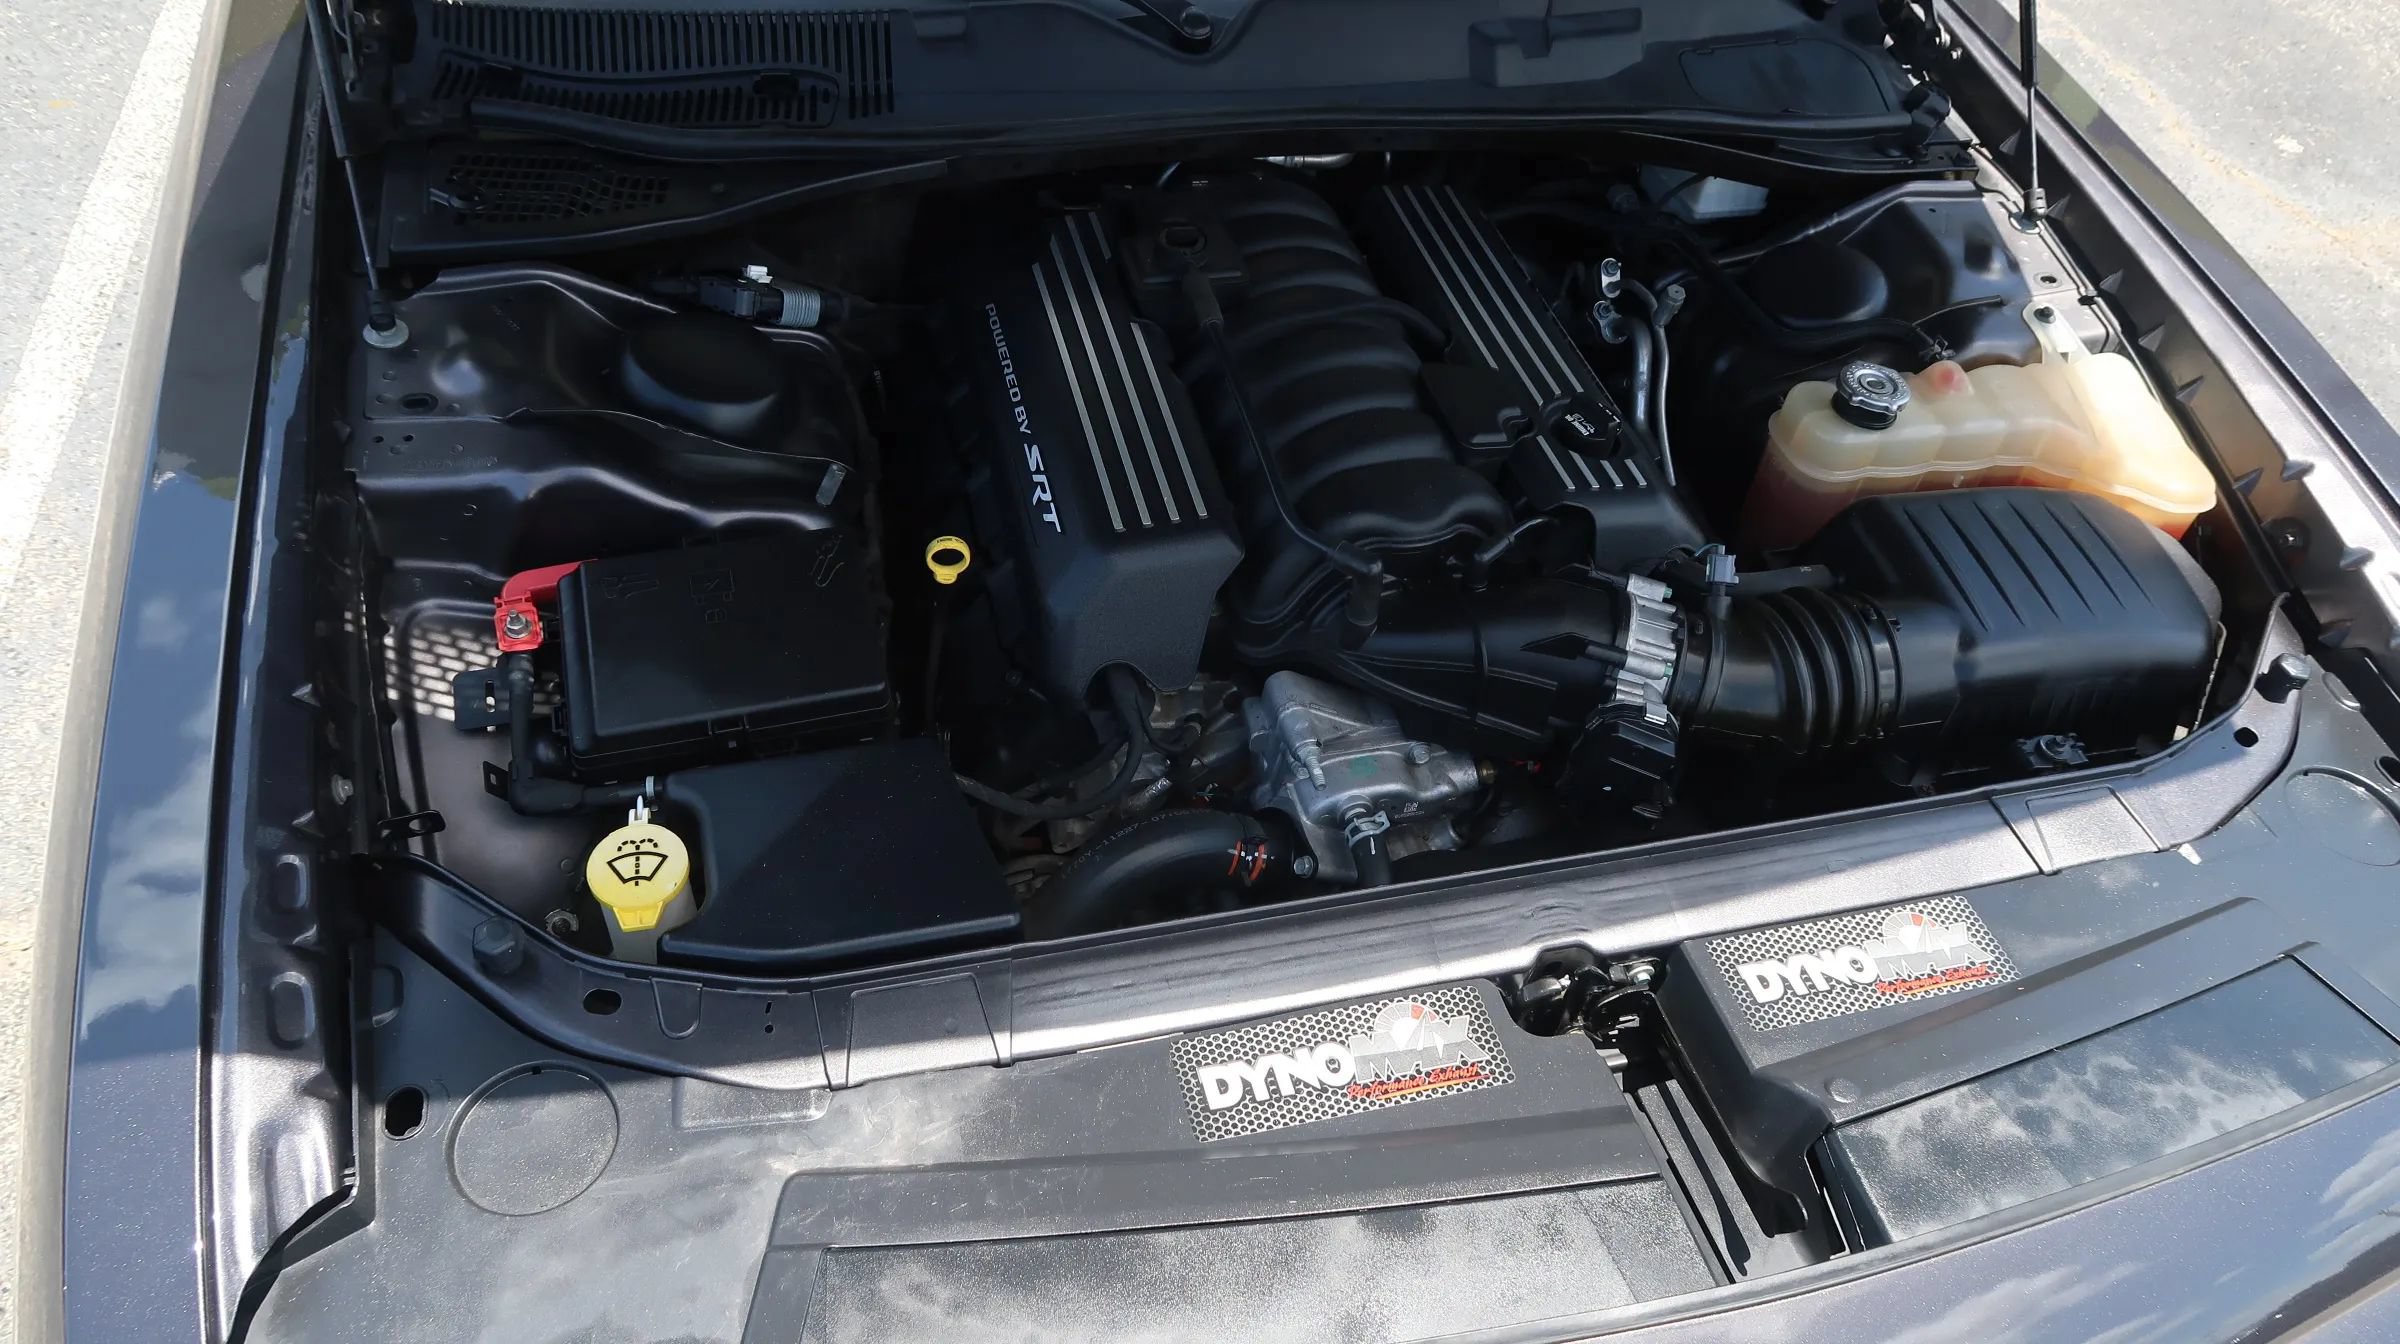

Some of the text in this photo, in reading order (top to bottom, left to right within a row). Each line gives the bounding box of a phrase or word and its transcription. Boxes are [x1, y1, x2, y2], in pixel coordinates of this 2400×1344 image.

[985, 303, 1061, 533] POWERED BY SRT
[1736, 913, 1995, 1004] DYNOMAX
[1196, 1006, 1491, 1111] DYNOMAX
[1347, 1062, 1480, 1099] Performance Exhaust
